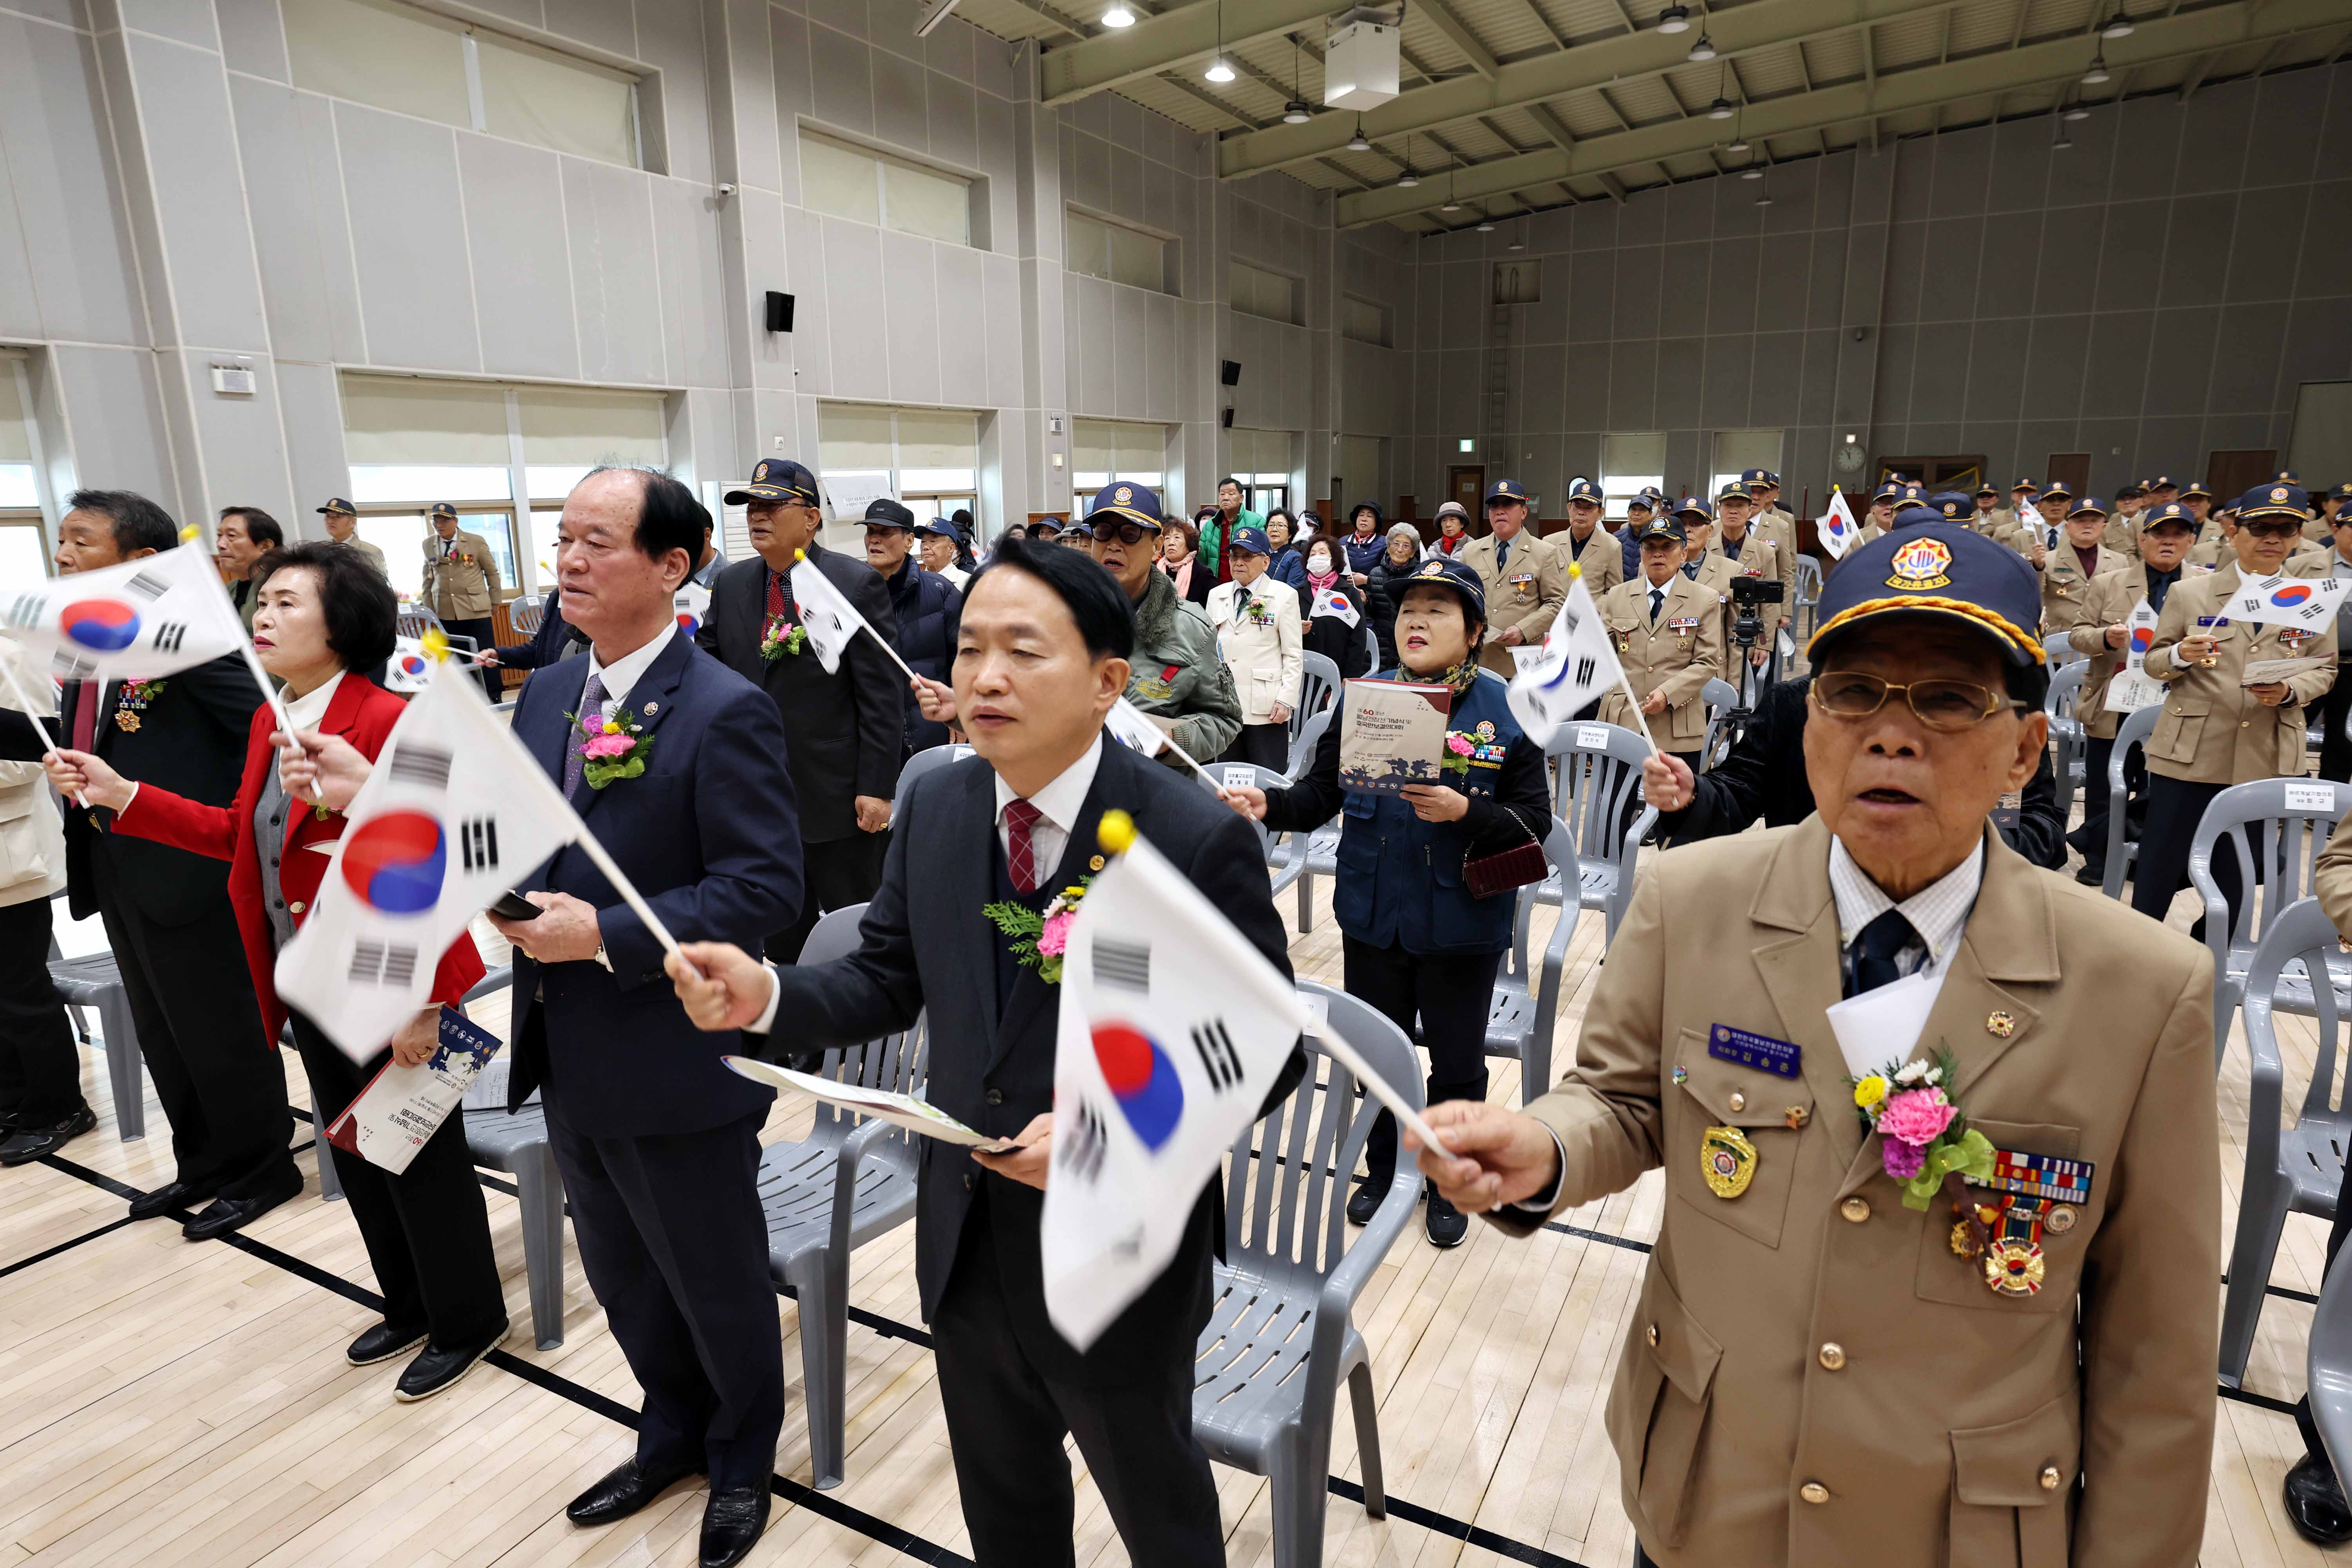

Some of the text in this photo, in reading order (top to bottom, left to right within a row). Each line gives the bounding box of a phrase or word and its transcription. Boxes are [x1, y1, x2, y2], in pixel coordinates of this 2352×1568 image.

[1891, 576, 1947, 588] 국가유공자
[1356, 720, 1404, 730] 호국안보결의대회
[394, 1116, 410, 1130] 기념식
[400, 1108, 437, 1130] 호국안보결의대회
[412, 1137, 422, 1146] 60
